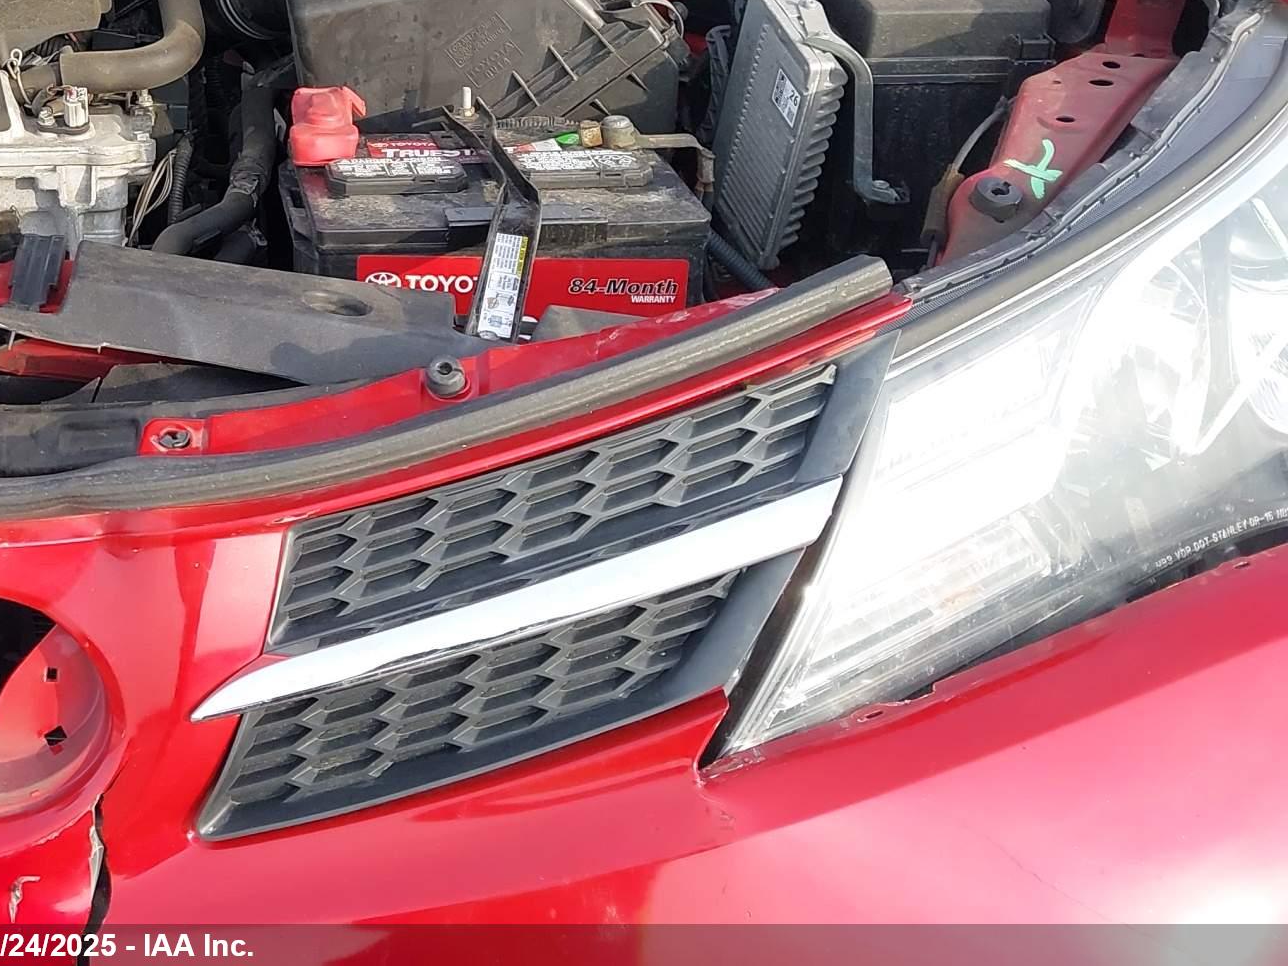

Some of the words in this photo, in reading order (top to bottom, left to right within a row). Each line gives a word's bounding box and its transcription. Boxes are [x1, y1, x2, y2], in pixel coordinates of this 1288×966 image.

[405, 274, 479, 293] TOYO
[568, 278, 678, 295] 84-Month
[631, 295, 676, 303] WARRANTY
